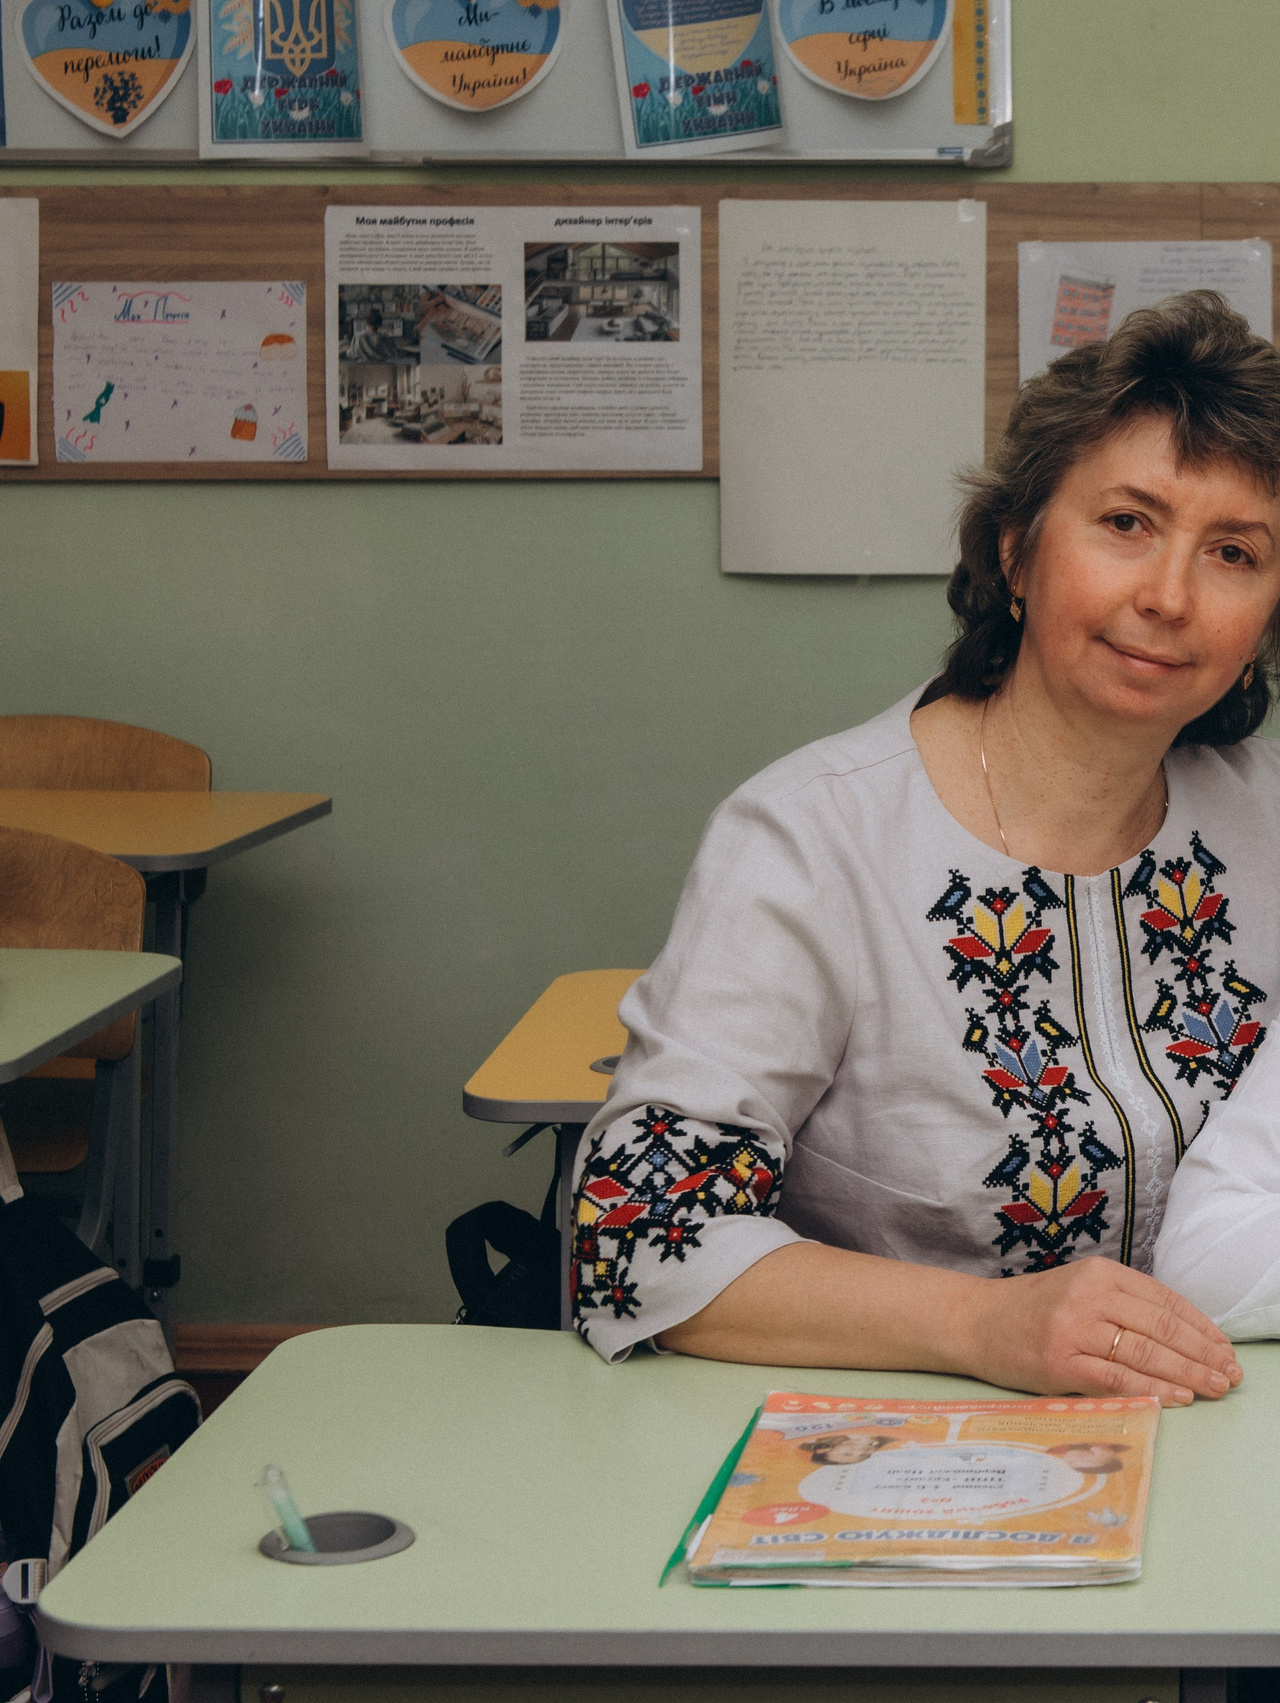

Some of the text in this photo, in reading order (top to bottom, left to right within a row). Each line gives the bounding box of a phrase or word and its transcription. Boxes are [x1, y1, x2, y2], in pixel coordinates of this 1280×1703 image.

[57, 2, 155, 39] Разом до
[63, 35, 162, 81] перемоги!
[439, 37, 533, 65] майбутнє
[451, 67, 528, 98] України!
[657, 60, 764, 94] ДЕРЖАВНИЙ
[835, 57, 908, 84] Україна
[260, 117, 336, 135] УКРАЇНИ
[681, 110, 756, 135] УКРАЇНИ
[355, 215, 475, 227] Моя майбутня професія
[553, 215, 603, 228] дизайнер
[772, 1512, 800, 1525] 4
[750, 1529, 1098, 1546] Я ДОСЛІДЖУЮ СВІТ
